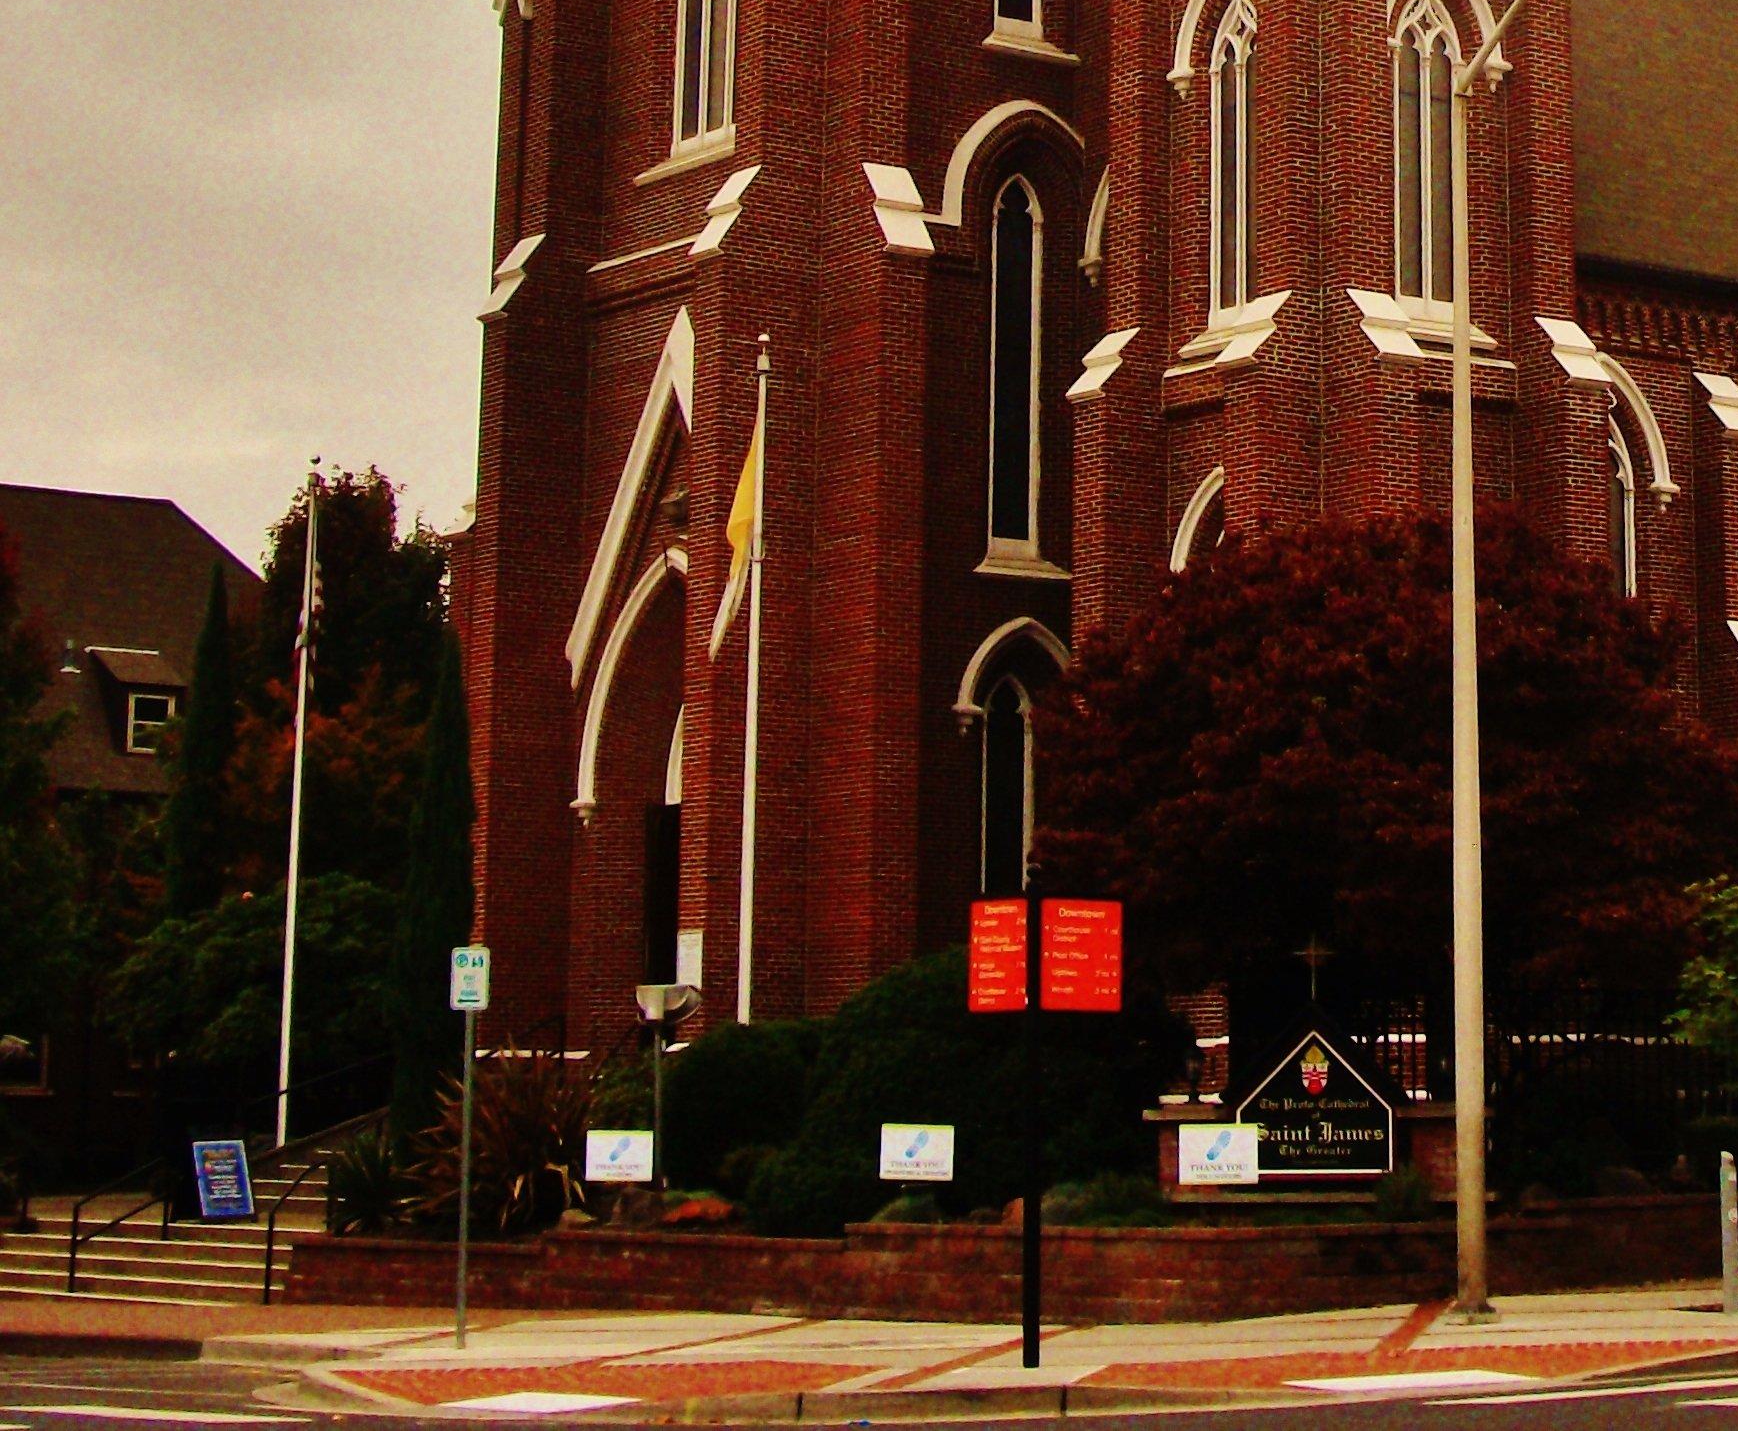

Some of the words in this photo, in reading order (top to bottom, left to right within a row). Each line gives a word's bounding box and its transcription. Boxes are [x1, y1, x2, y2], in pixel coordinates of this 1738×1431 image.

[1059, 907, 1105, 919] Downtown
[1260, 1098, 1280, 1110] The
[1257, 1123, 1311, 1141] Saint
[1318, 1121, 1385, 1144] James
[1279, 1144, 1301, 1157] The
[1305, 1145, 1352, 1157] Greater
